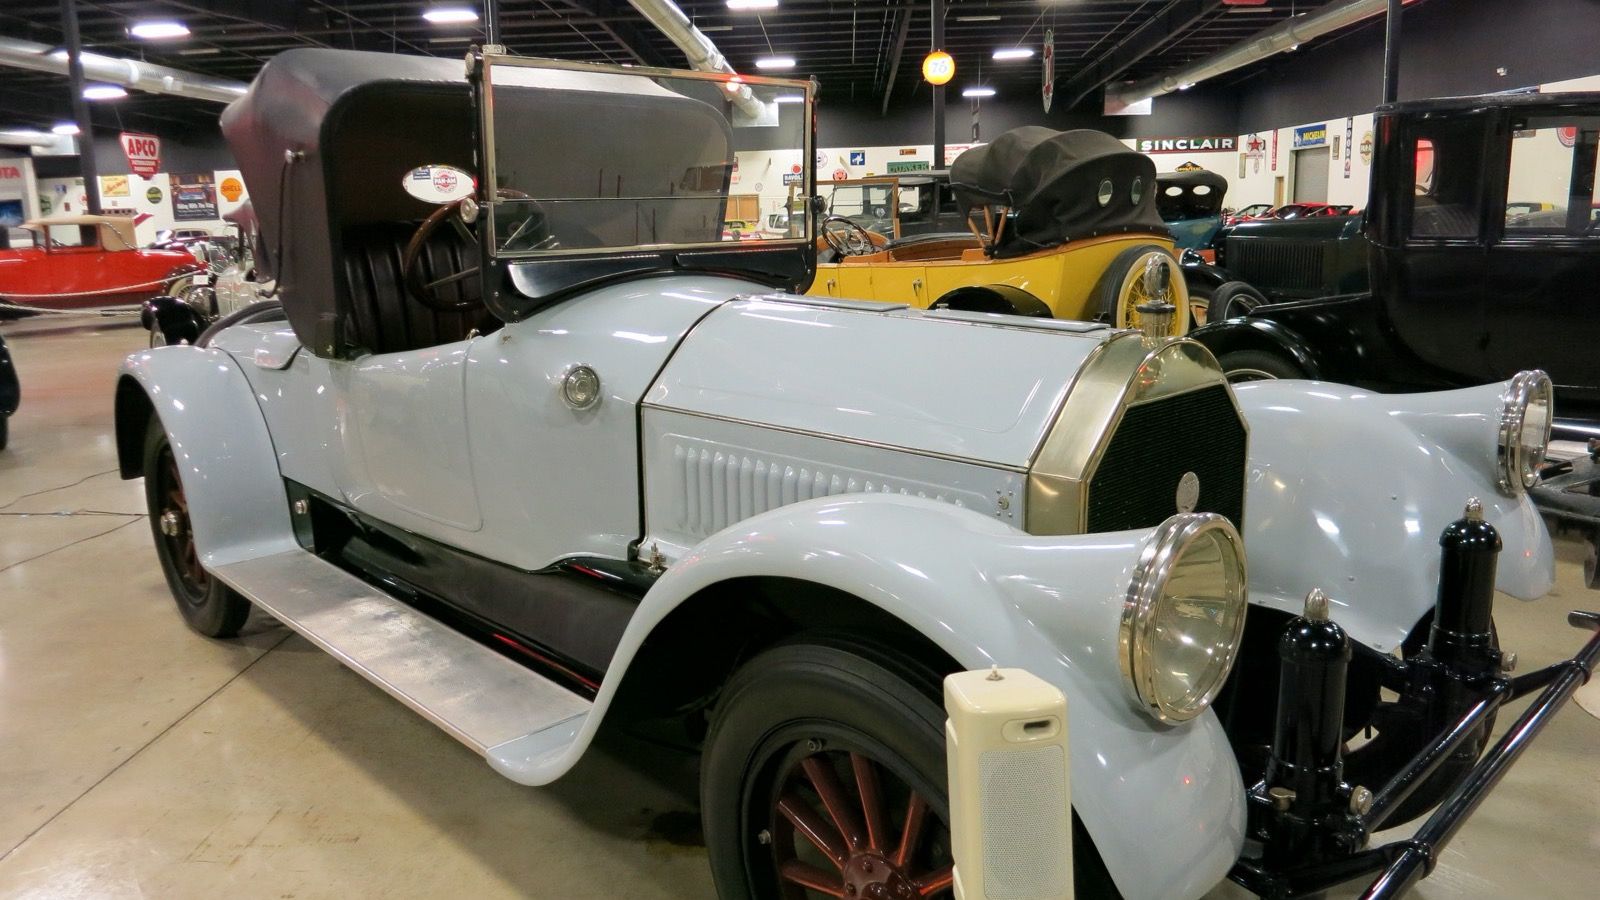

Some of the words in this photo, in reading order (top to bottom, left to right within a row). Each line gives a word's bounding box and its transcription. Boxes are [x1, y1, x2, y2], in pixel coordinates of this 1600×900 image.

[931, 60, 948, 74] 76
[1302, 130, 1326, 141] MICHELIN
[128, 138, 156, 157] APCO
[1140, 138, 1233, 151] SINCLAIR
[221, 184, 241, 192] SHELL
